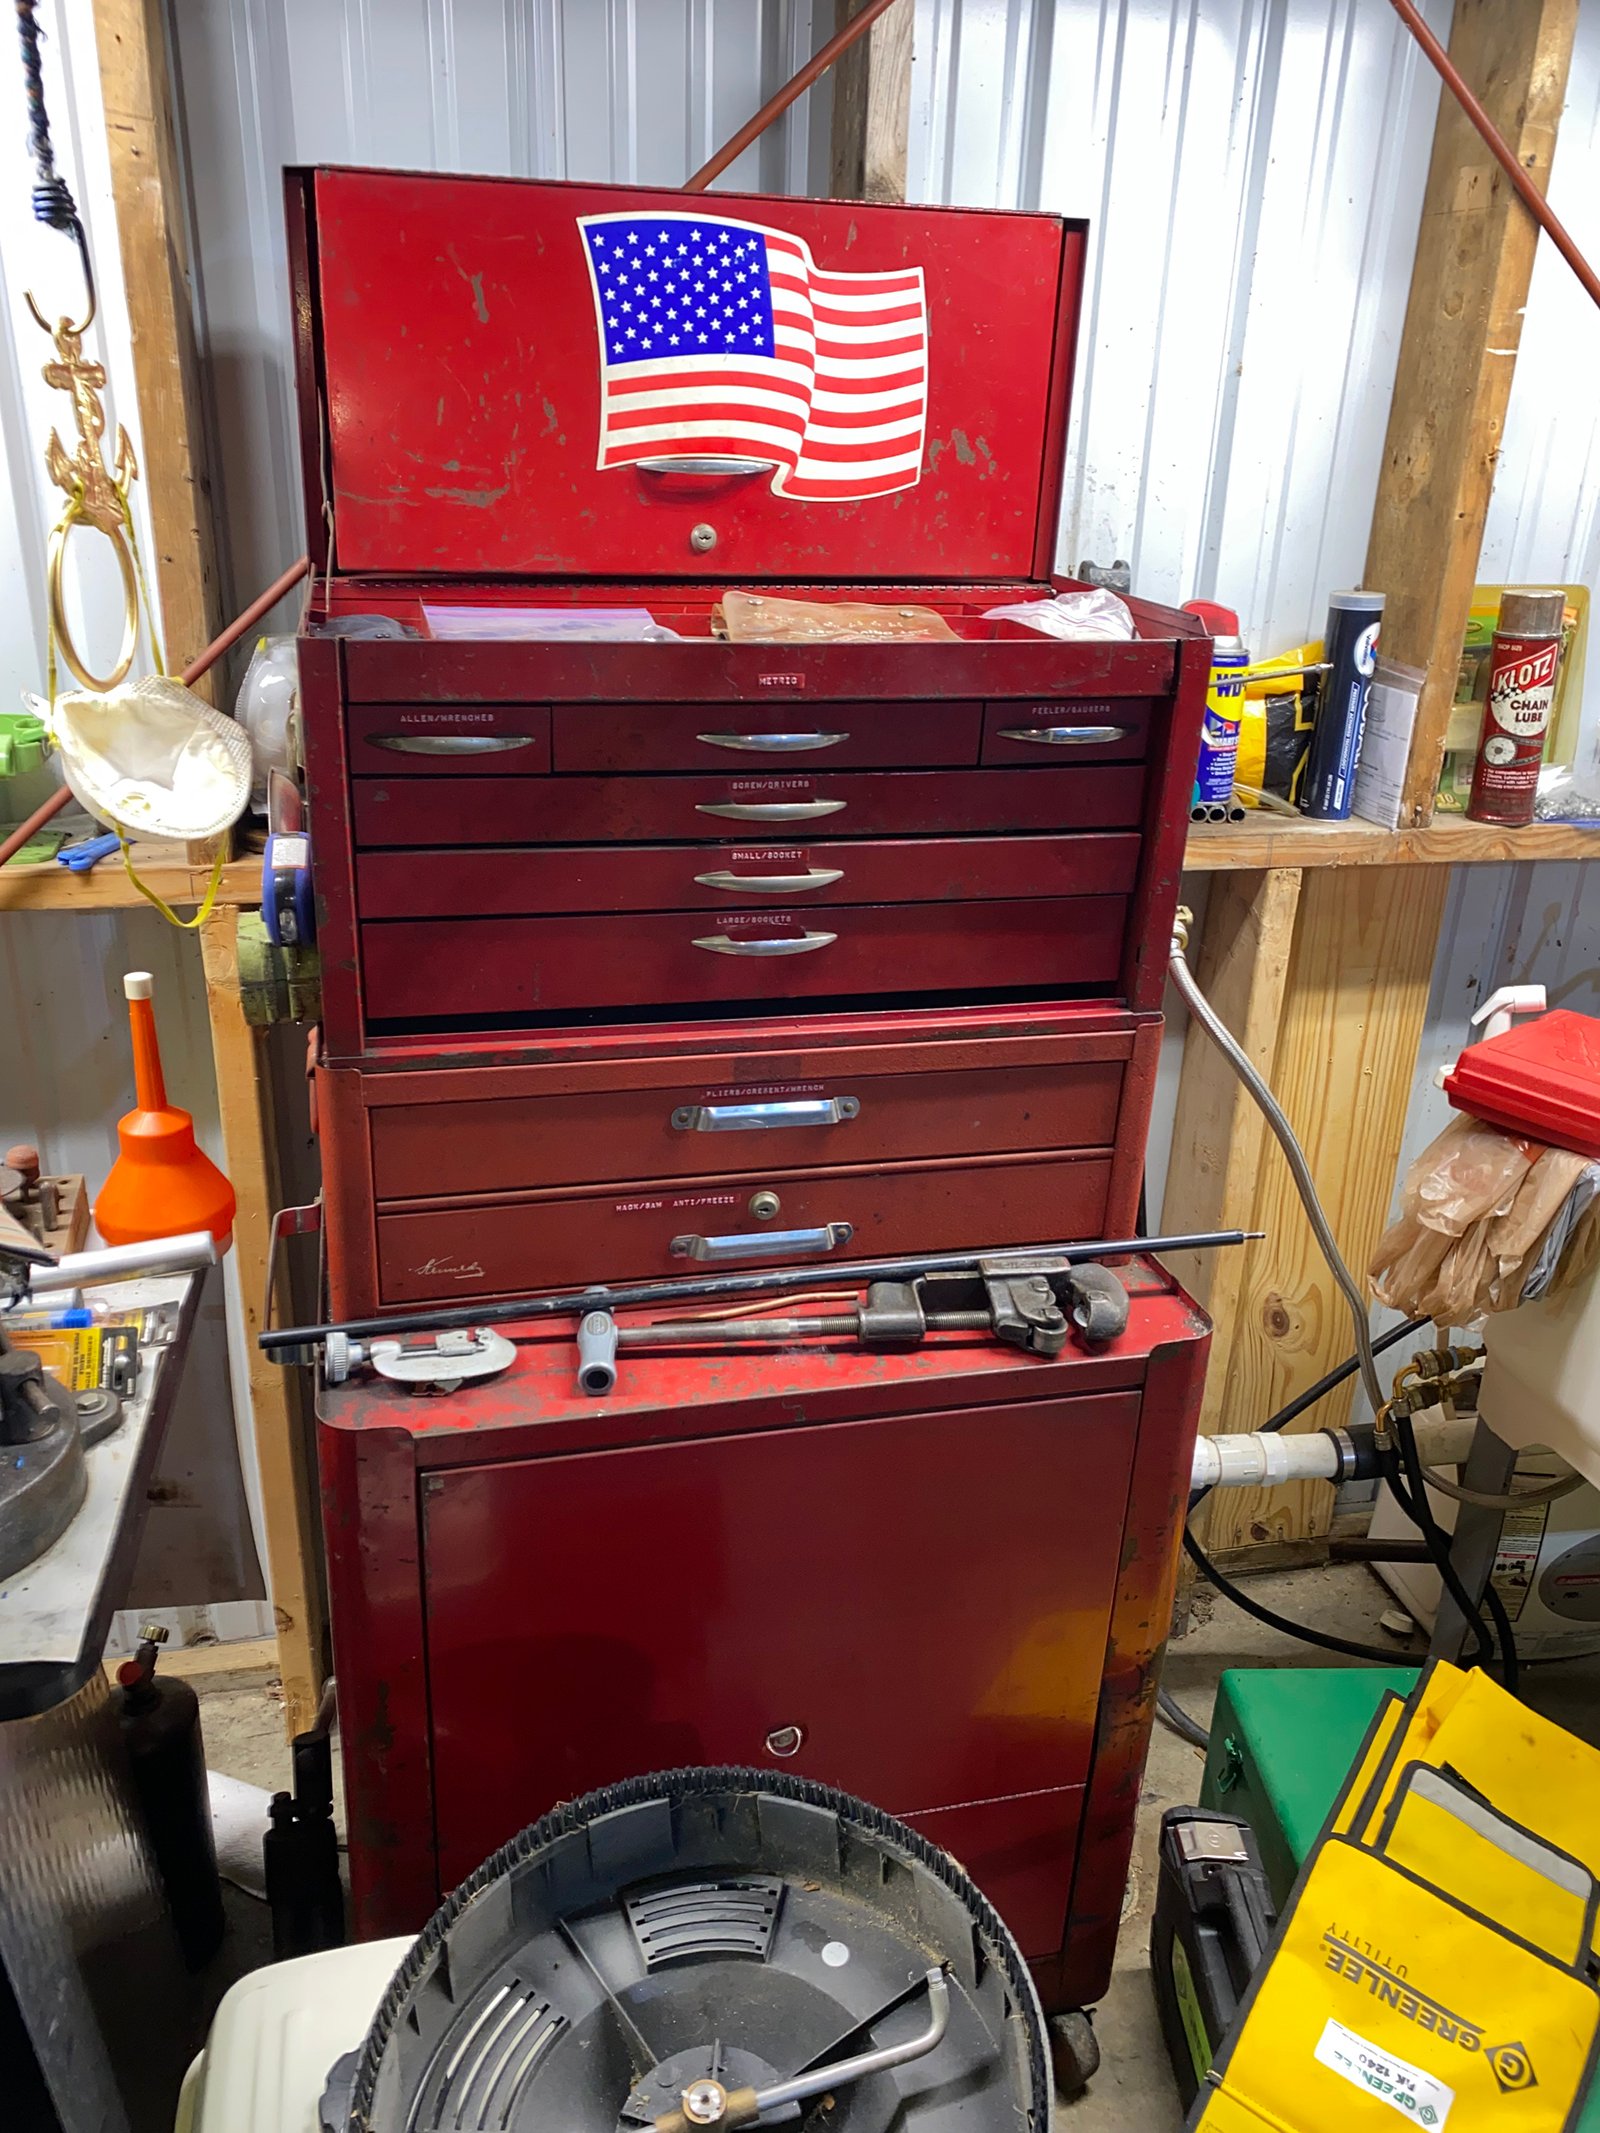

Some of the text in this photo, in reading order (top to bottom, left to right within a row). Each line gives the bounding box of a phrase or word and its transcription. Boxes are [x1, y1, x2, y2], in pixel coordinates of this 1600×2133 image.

[1497, 653, 1553, 693] KLOTZ
[759, 676, 798, 686] METRIC
[1510, 700, 1549, 711] CHAIN
[400, 713, 495, 723] ALLEN/WRENCHES
[1515, 712, 1543, 723] LUBE
[732, 780, 810, 790] SCREW/DRIVERS
[732, 851, 802, 860] SMALL/SOCKET
[716, 915, 792, 925] LARGE/SOCKETS
[616, 1201, 662, 1212] HACK/SAW
[1326, 1921, 1408, 1979] UTILITY
[1324, 1947, 1481, 2053] GREENLEE
